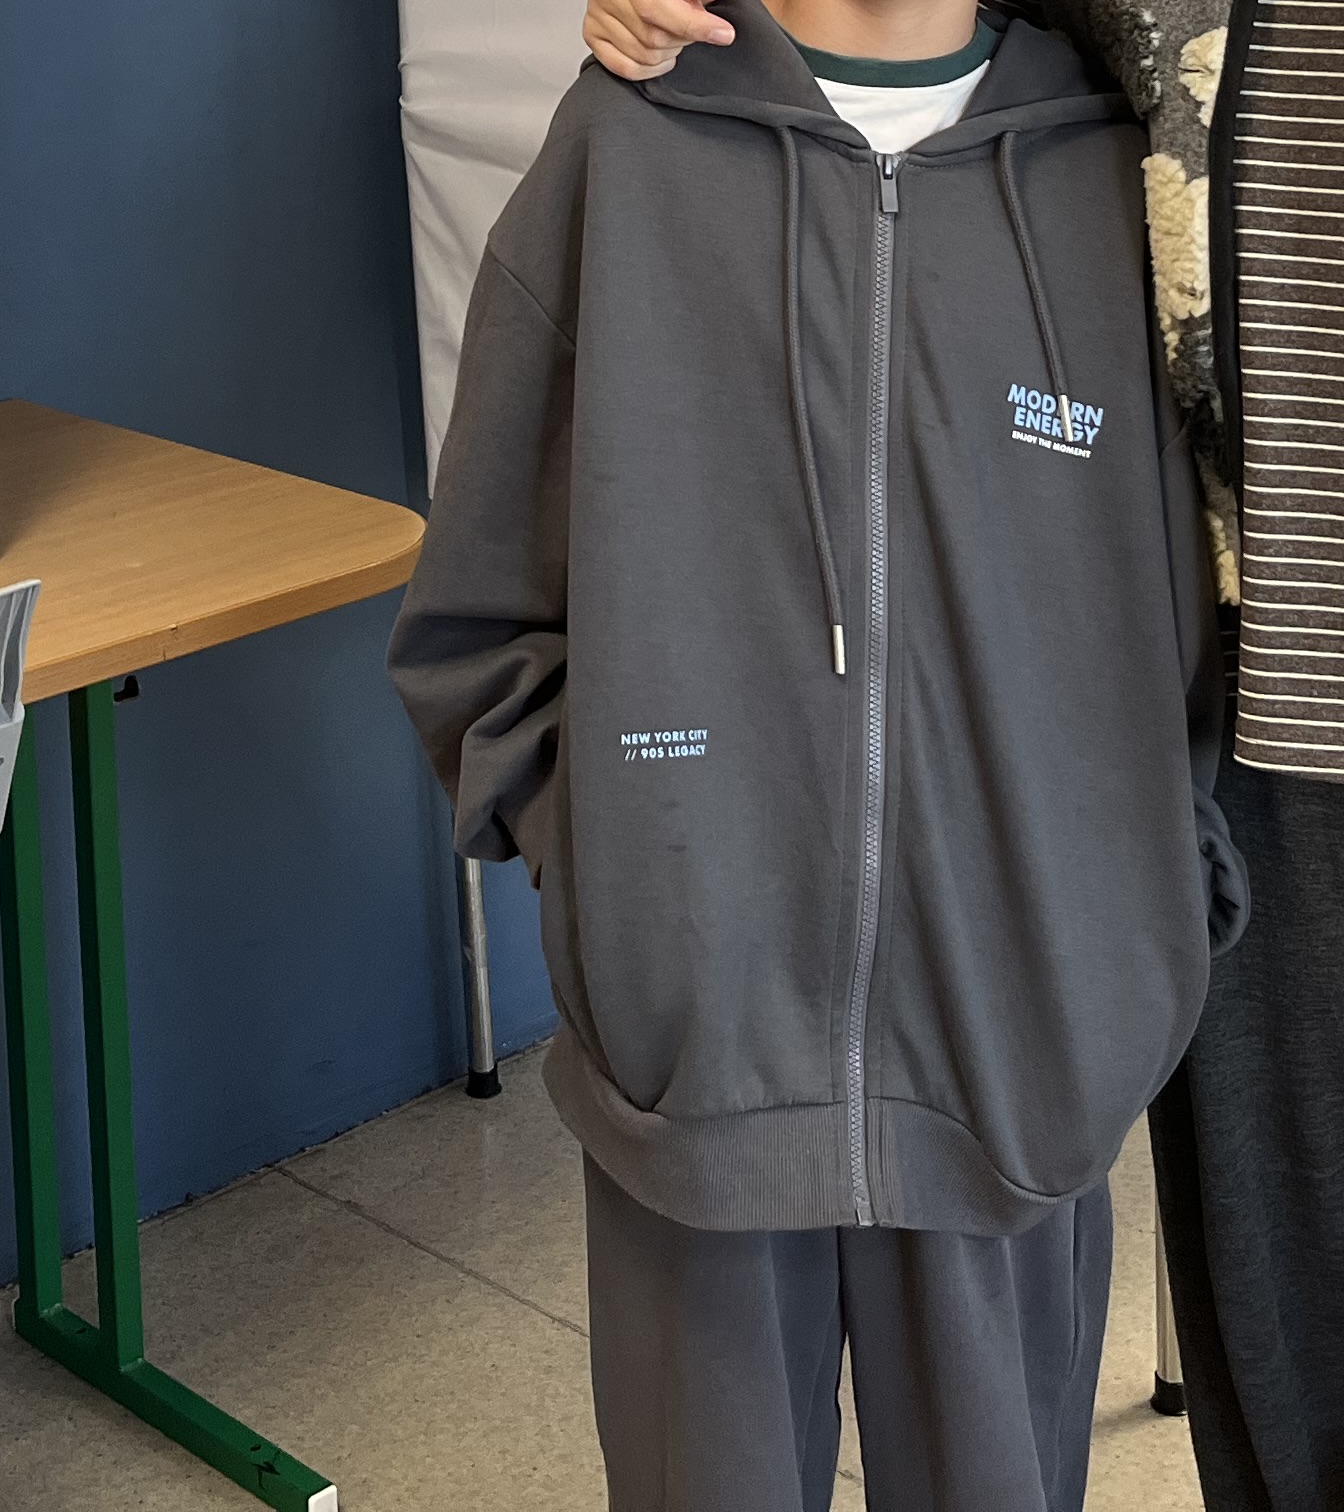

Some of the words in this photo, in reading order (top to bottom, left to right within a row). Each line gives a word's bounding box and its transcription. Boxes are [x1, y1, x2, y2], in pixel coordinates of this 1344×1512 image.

[1007, 383, 1104, 426] MODRN
[1012, 430, 1037, 444] ENJOY
[1038, 437, 1052, 449] THE
[1052, 442, 1091, 458] MOMENT
[620, 732, 651, 745] NEW
[654, 730, 687, 743] YORK
[688, 728, 708, 742] CITY
[640, 746, 665, 759] 90S
[668, 744, 706, 758] LEGACY
